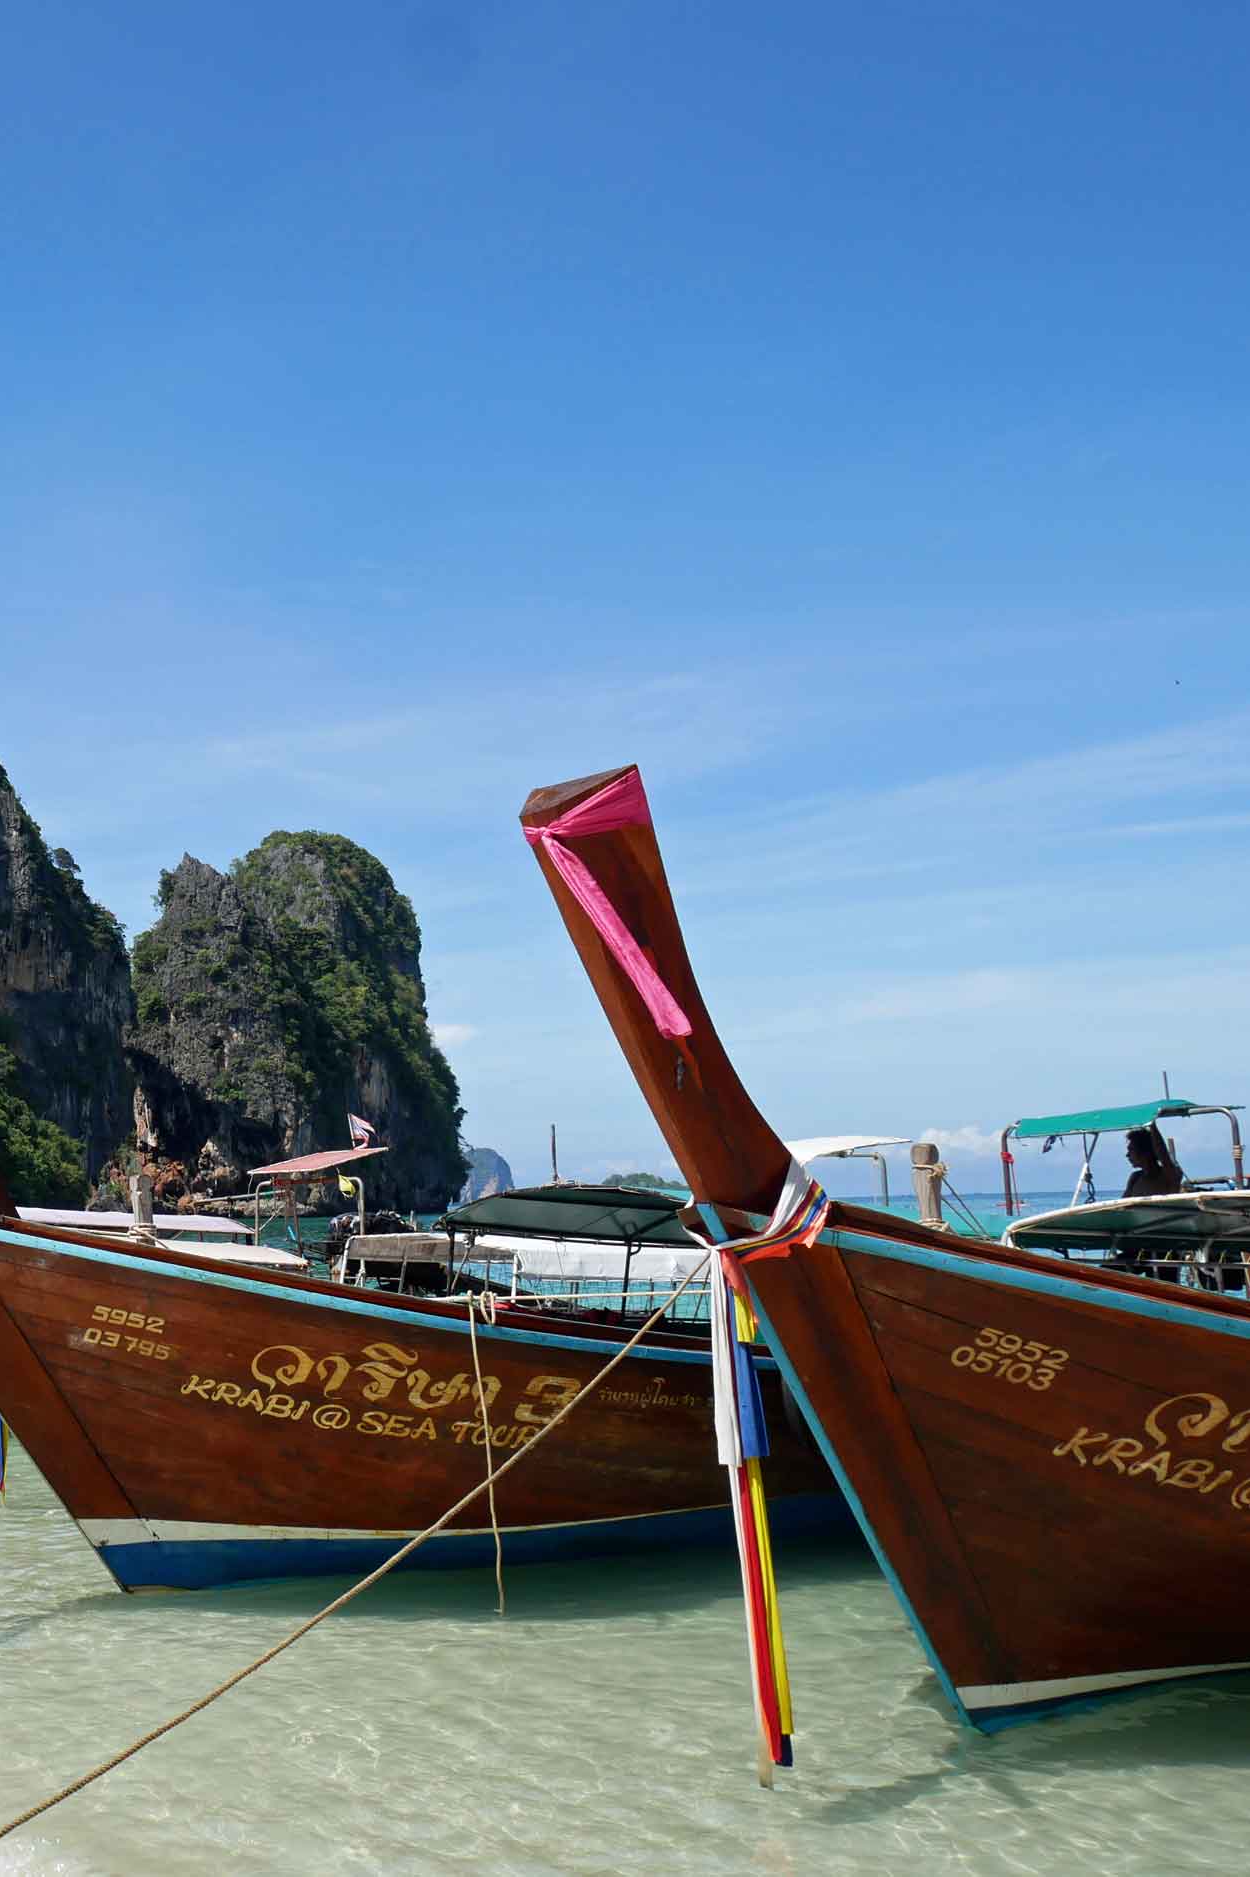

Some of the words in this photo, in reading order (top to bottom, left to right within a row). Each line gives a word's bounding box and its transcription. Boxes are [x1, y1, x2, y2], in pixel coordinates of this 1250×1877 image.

[91, 1304, 166, 1335] 5952
[83, 1327, 173, 1362] 03795
[973, 1327, 1070, 1371] 5952
[950, 1345, 1056, 1391] 05103
[180, 1375, 310, 1424] KRABI
[356, 1411, 437, 1442] SEA
[448, 1419, 542, 1450] TOUR
[513, 1375, 583, 1425] 3
[1051, 1426, 1234, 1494] KRABI
